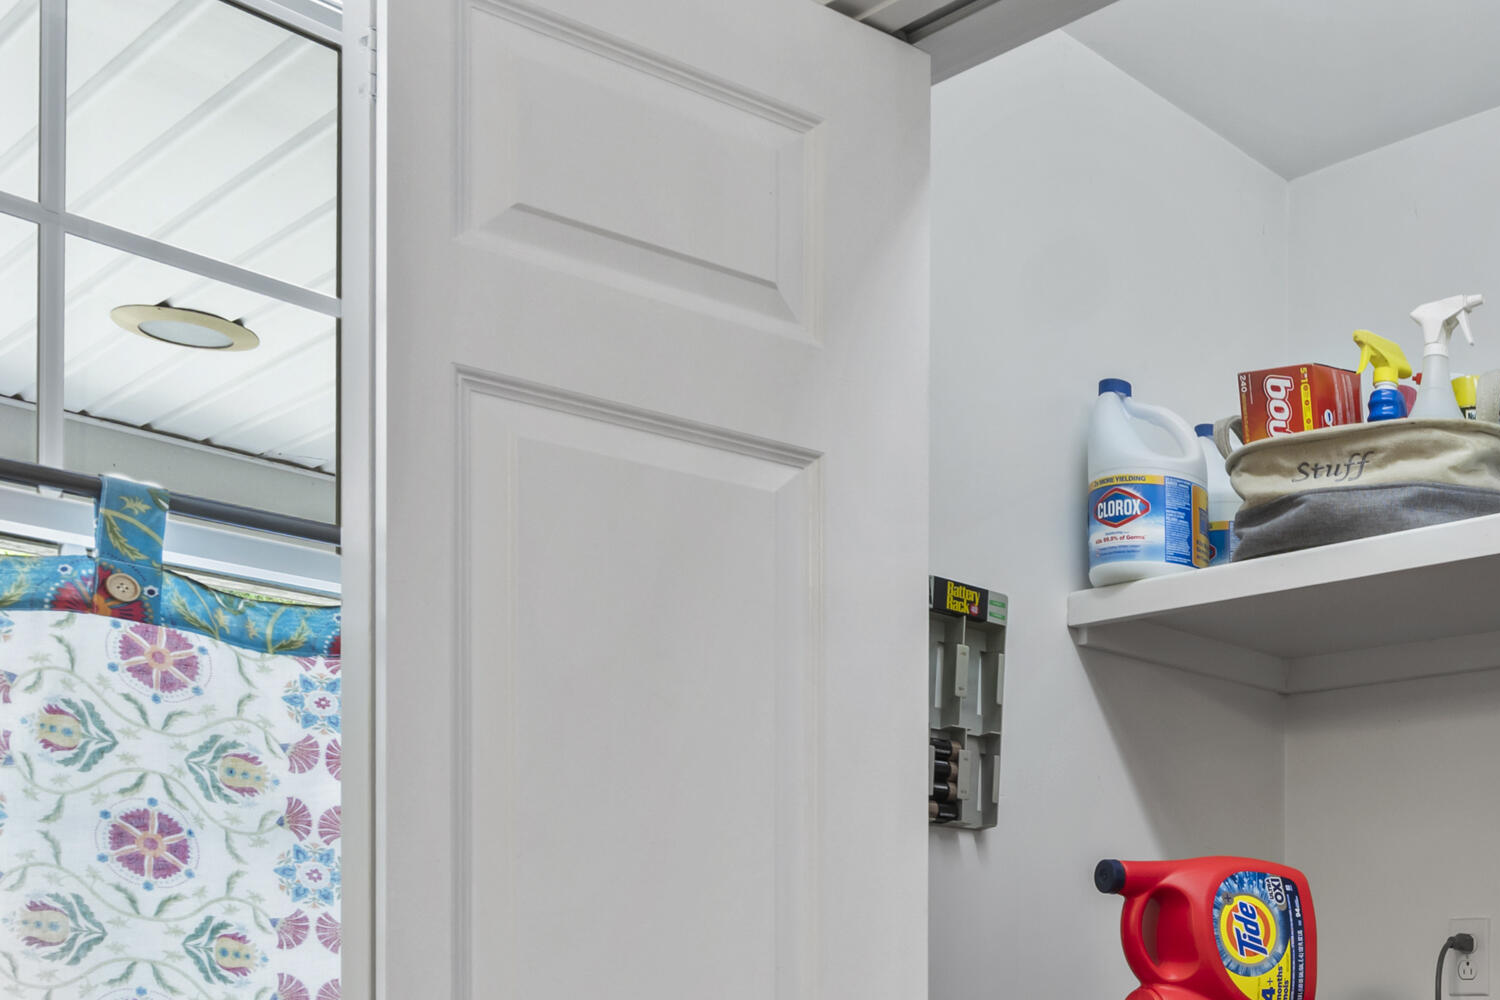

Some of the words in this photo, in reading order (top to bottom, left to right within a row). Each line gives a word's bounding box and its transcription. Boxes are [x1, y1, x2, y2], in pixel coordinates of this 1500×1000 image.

[1239, 374, 1248, 393] 240
[1291, 450, 1375, 483] Stuff
[1115, 474, 1146, 483] YIELDING
[1097, 498, 1142, 520] CLOROX
[946, 581, 980, 607] Battery
[946, 594, 970, 615] Rack
[1266, 879, 1274, 900] ULTRA
[1271, 877, 1286, 905] OXI
[1232, 900, 1269, 958] Tide
